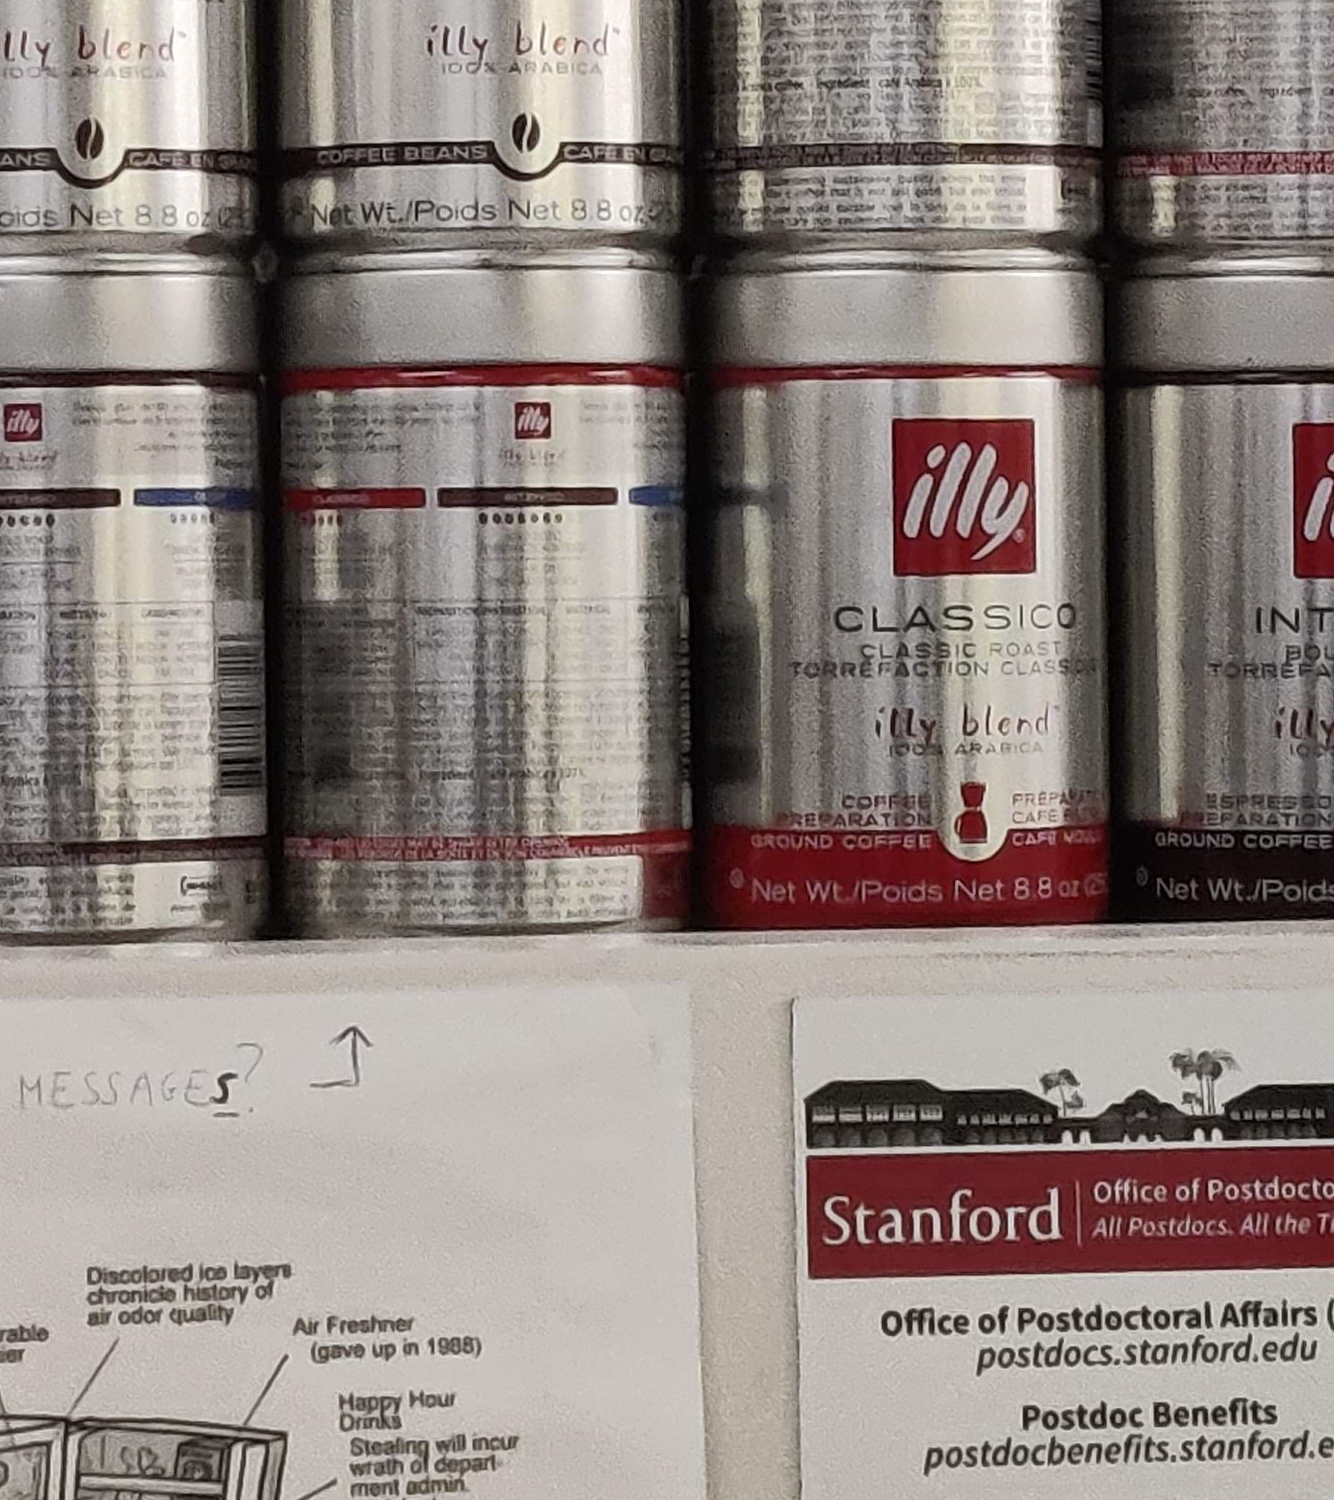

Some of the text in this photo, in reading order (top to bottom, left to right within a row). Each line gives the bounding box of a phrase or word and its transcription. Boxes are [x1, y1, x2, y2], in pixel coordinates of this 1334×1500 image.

[509, 62, 602, 75] ARABICA
[404, 146, 487, 160] BEANS
[508, 199, 559, 221] Net
[903, 442, 1029, 561] illy
[834, 604, 1076, 633] CLASSICO
[861, 641, 1061, 660] CLASSIC ROAST
[751, 834, 932, 850] GROUND COFFEE
[1156, 833, 1334, 849] GROUND COFFEE
[751, 877, 1052, 902] Net Net 8.8
[1156, 877, 1198, 899] Net
[1093, 1179, 1167, 1203] Office
[1175, 1179, 1200, 1201] of
[821, 1187, 1064, 1246] Stanford
[1093, 1216, 1120, 1238] All
[1128, 1214, 1232, 1237] Postdocs.
[1240, 1212, 1266, 1236] All
[1275, 1213, 1310, 1234] the
[87, 1264, 193, 1285] Discolored
[234, 1262, 291, 1283] layers
[87, 1279, 274, 1305] chronicle history of
[87, 1304, 234, 1326] air odor quality
[293, 1314, 414, 1336] Air Freshner
[880, 1308, 970, 1337] Office
[978, 1306, 1010, 1334] of
[1018, 1302, 1213, 1333] Postdoctoral
[1220, 1300, 1318, 1328] Affairs
[311, 1341, 365, 1364] (gave
[372, 1344, 396, 1362] up
[403, 1338, 419, 1356] in
[975, 1332, 1318, 1375] postdocs.stanford.edu
[339, 1390, 455, 1414] Happy Hour
[1022, 1398, 1278, 1430] Postdoc Benefits
[339, 1413, 402, 1432] Drinks
[350, 1433, 519, 1460] Stealing will incur
[349, 1458, 403, 1478] wrath
[410, 1457, 428, 1474] of
